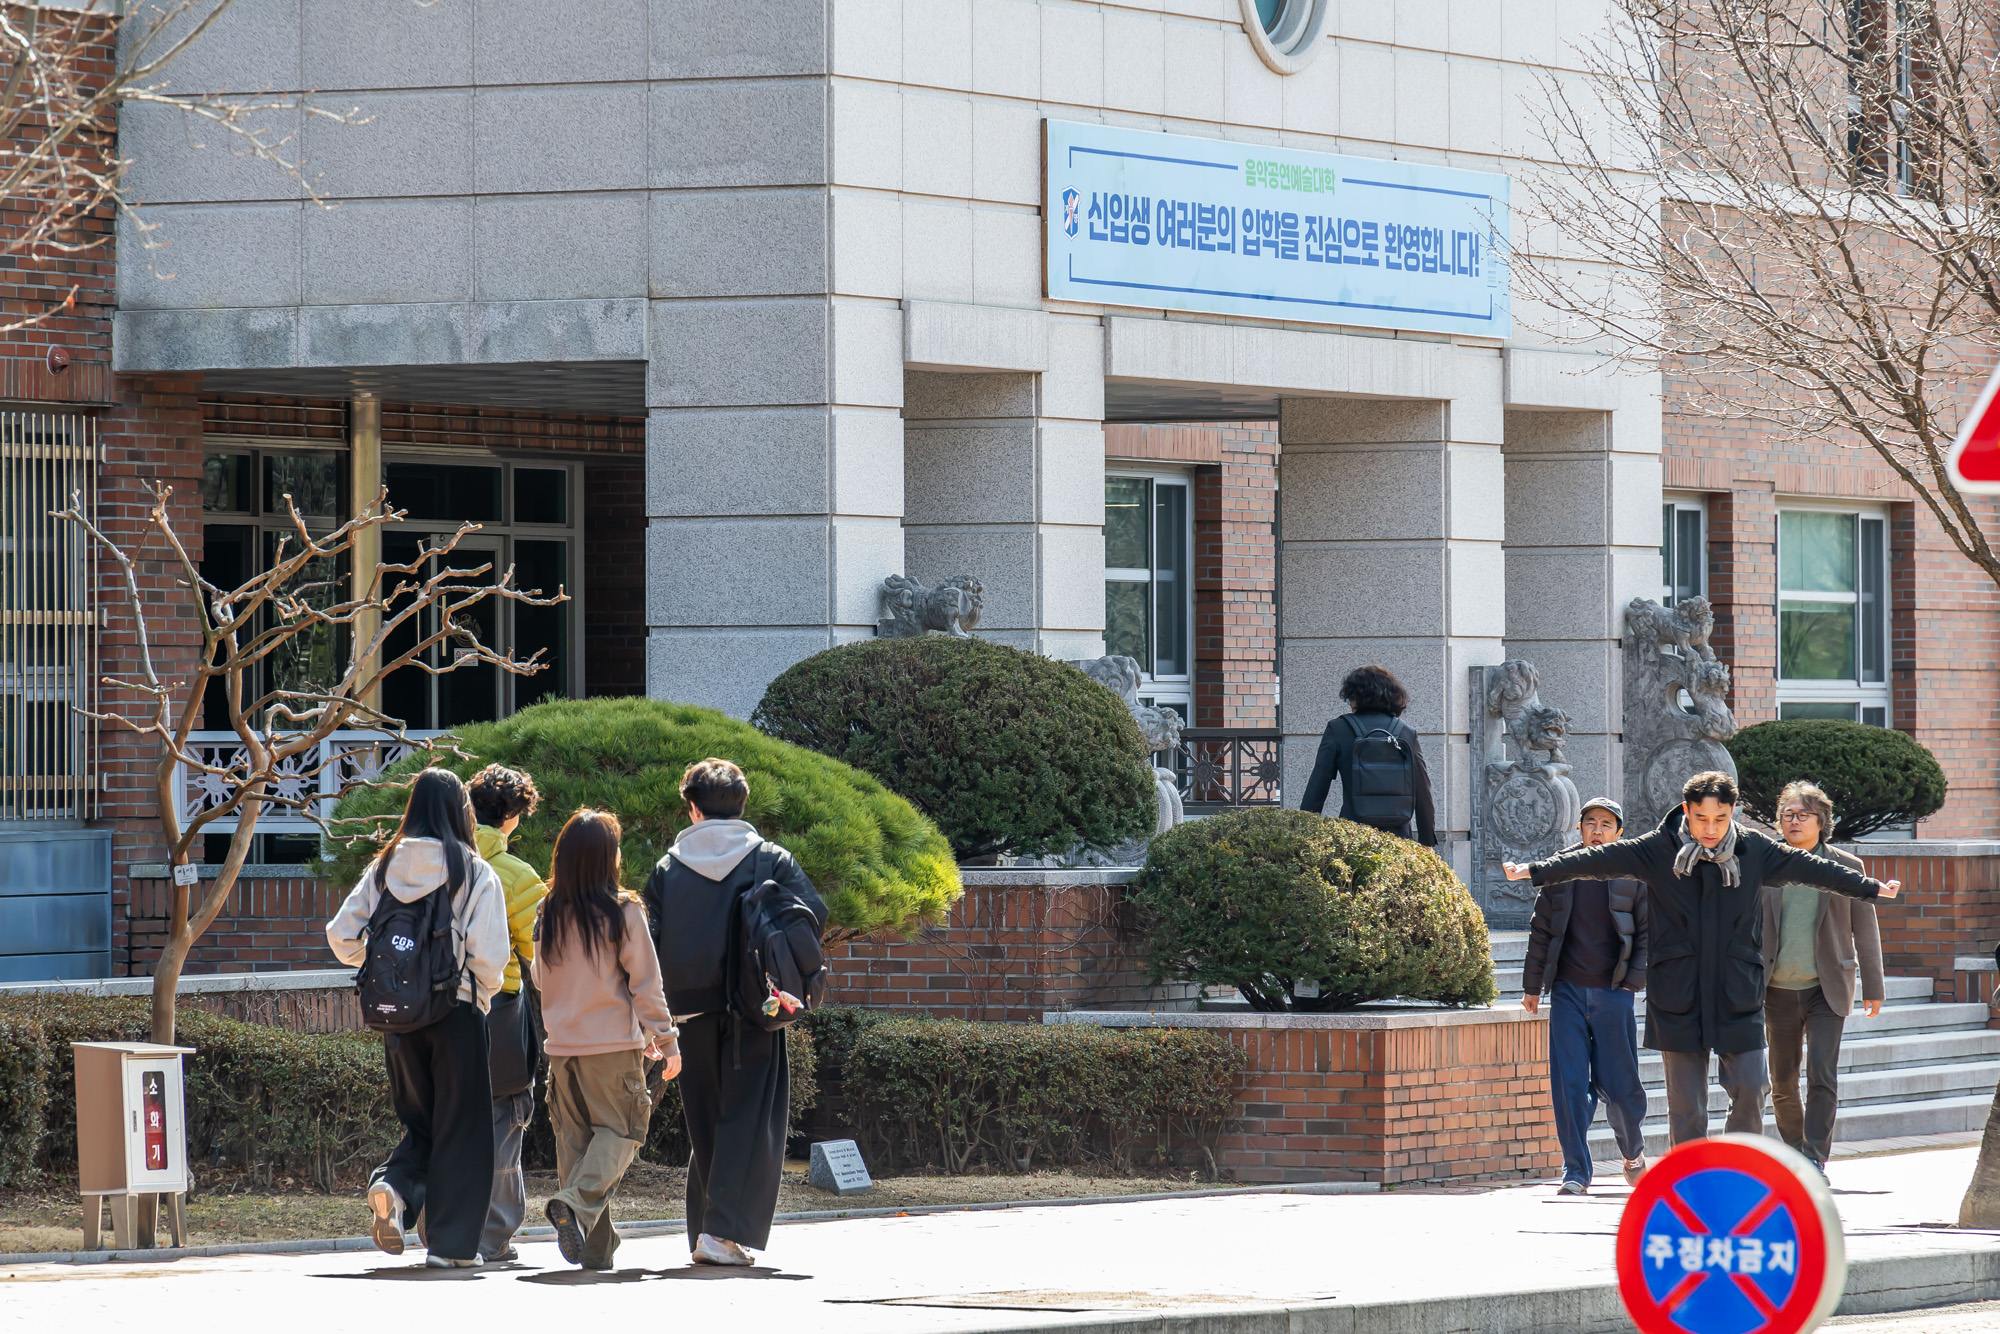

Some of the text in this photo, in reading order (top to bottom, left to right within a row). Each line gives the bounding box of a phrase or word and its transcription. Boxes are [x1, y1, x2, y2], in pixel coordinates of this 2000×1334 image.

[1245, 158, 1336, 196] 음악공연예술대학
[1088, 191, 1150, 246] 신입생
[1156, 198, 1236, 254] 여러분의
[1242, 208, 1299, 261] 입학을
[1305, 215, 1379, 267] 진심으로
[1384, 222, 1479, 277] 환영합니다!
[148, 1077, 161, 1161] 소화기
[1645, 1234, 1795, 1276] 주정차금지
